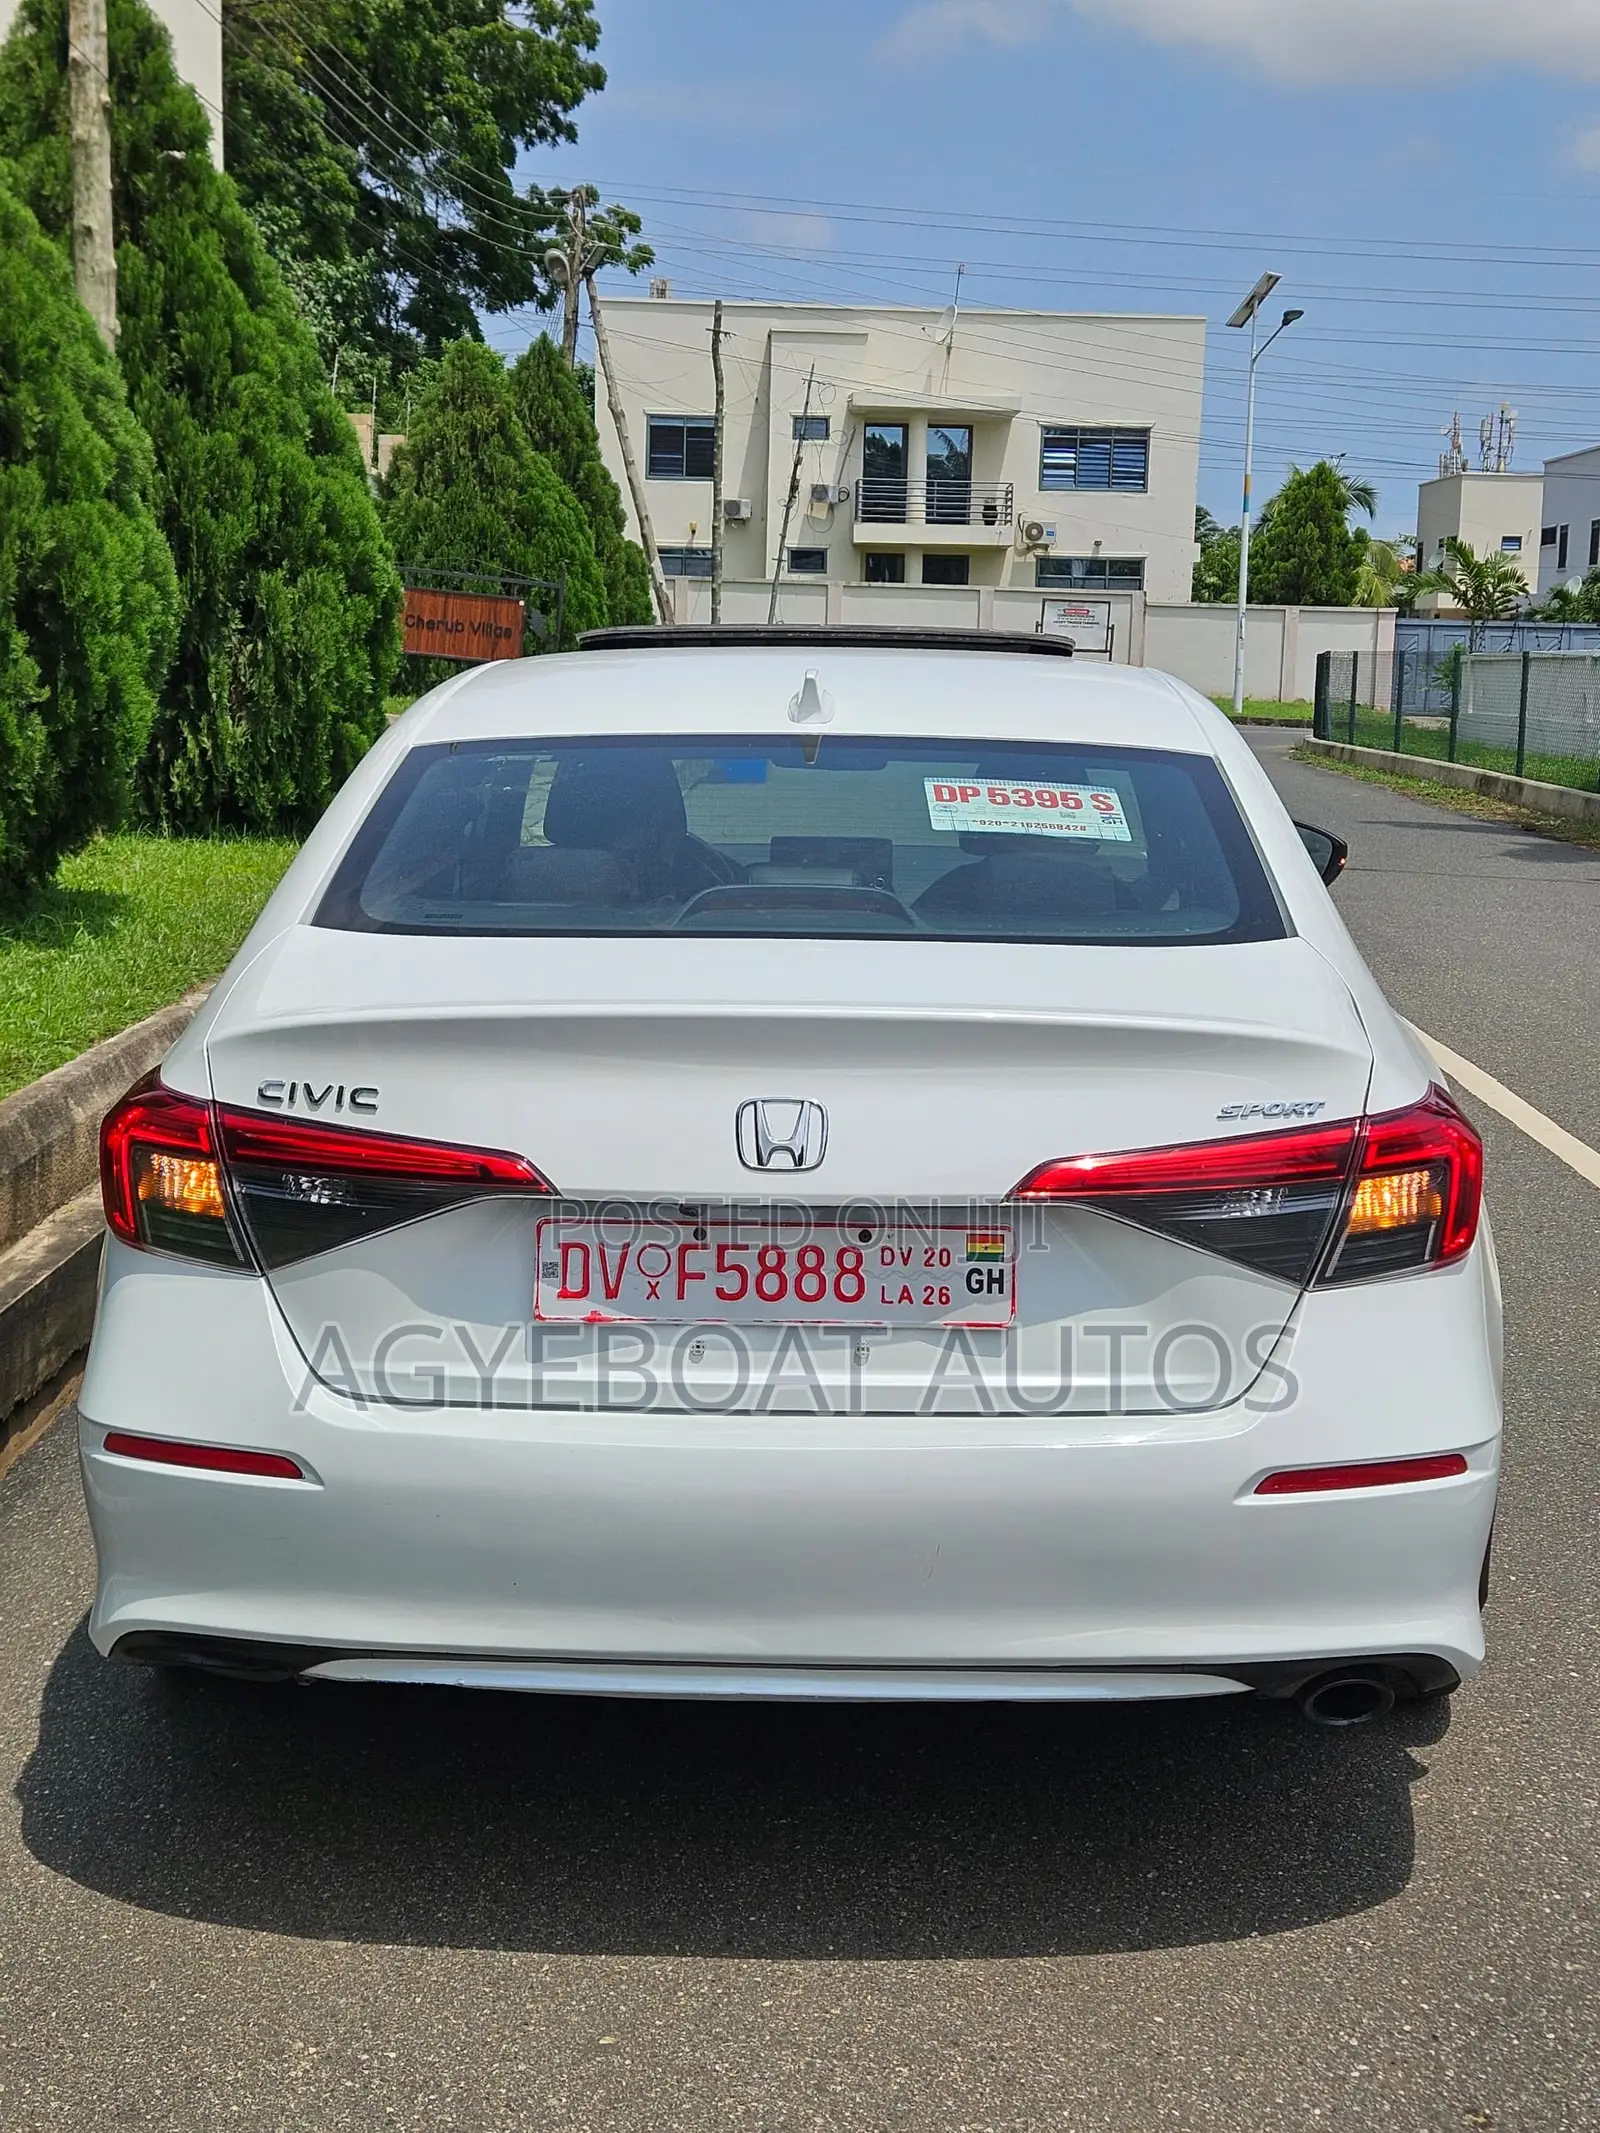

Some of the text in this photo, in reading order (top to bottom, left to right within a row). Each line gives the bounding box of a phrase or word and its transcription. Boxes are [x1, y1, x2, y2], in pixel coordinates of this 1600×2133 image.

[404, 614, 464, 633] Cherub
[932, 784, 981, 803] DP
[987, 787, 1084, 810] 5395
[1089, 792, 1115, 812] S
[257, 1079, 379, 1112] CIVIC
[1216, 1101, 1326, 1120] SPORT
[880, 1246, 951, 1267] DV 20
[557, 1241, 631, 1300] DV
[676, 1242, 867, 1303] F5888
[965, 1267, 1005, 1295] GH
[880, 1284, 951, 1305] LA 26
